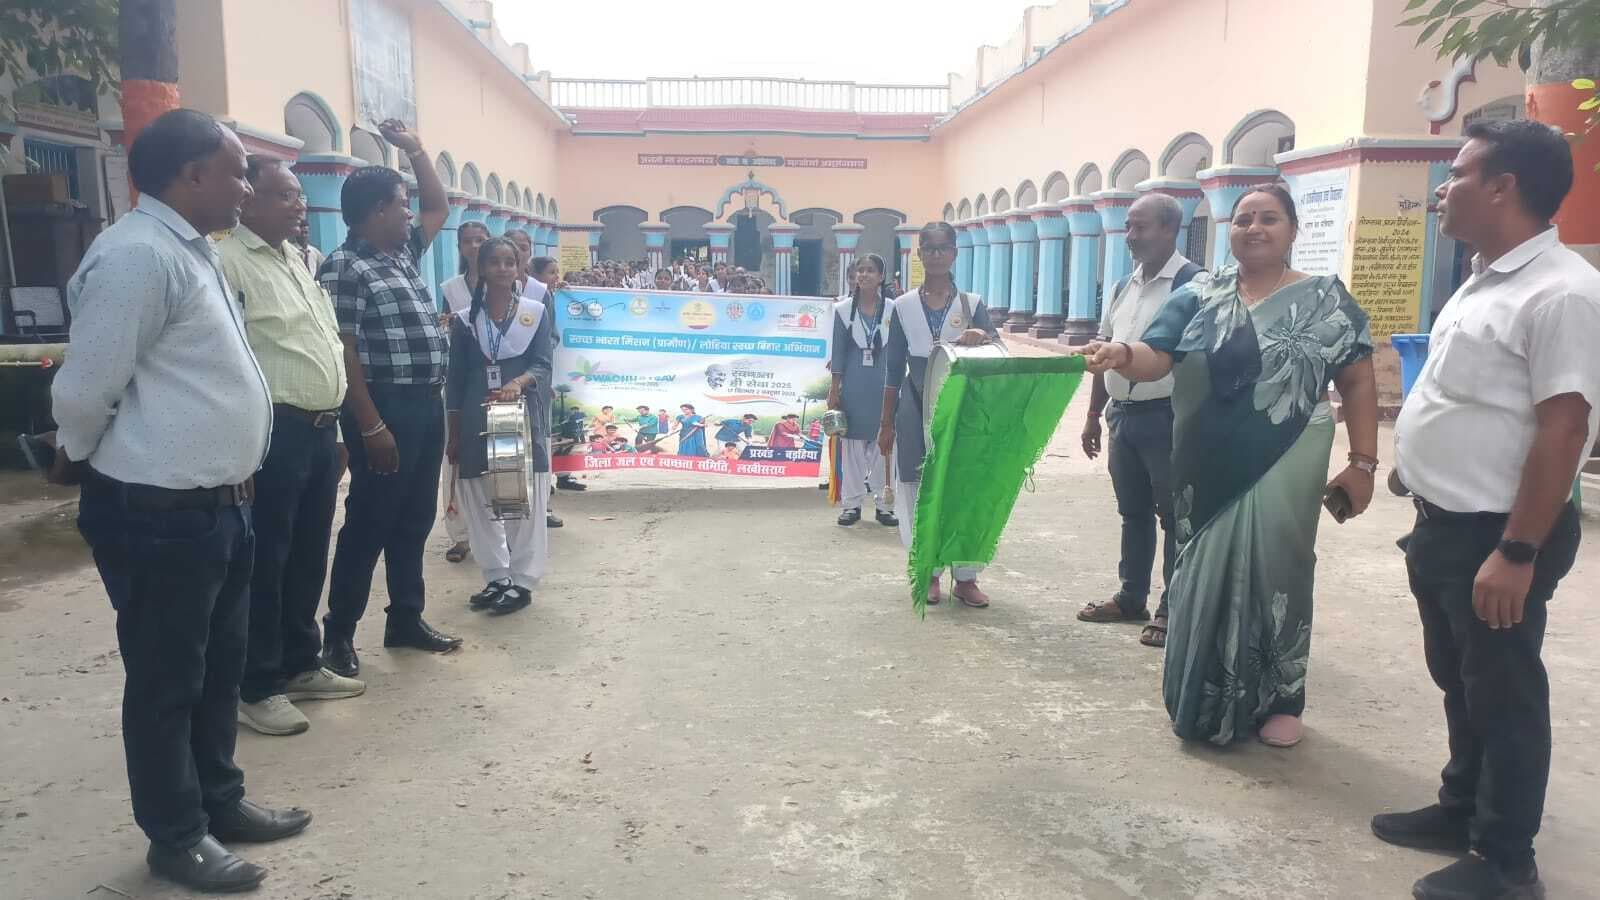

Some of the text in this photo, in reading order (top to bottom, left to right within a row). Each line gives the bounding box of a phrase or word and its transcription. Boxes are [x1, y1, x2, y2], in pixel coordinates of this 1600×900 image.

[1391, 228, 1410, 236] 2024
[568, 334, 593, 344] स्वच्छ
[595, 334, 620, 345] भारत
[621, 334, 650, 346] मिशन
[757, 340, 781, 352] बिहार
[784, 341, 821, 354] अभियान
[749, 448, 774, 460] प्रखंड
[784, 449, 818, 461] बड़हिया
[583, 456, 613, 469] जिला
[615, 457, 635, 467] जल
[639, 456, 655, 468] एवं
[658, 459, 693, 470] स्वच्छता
[736, 462, 786, 476] लखीसराय
